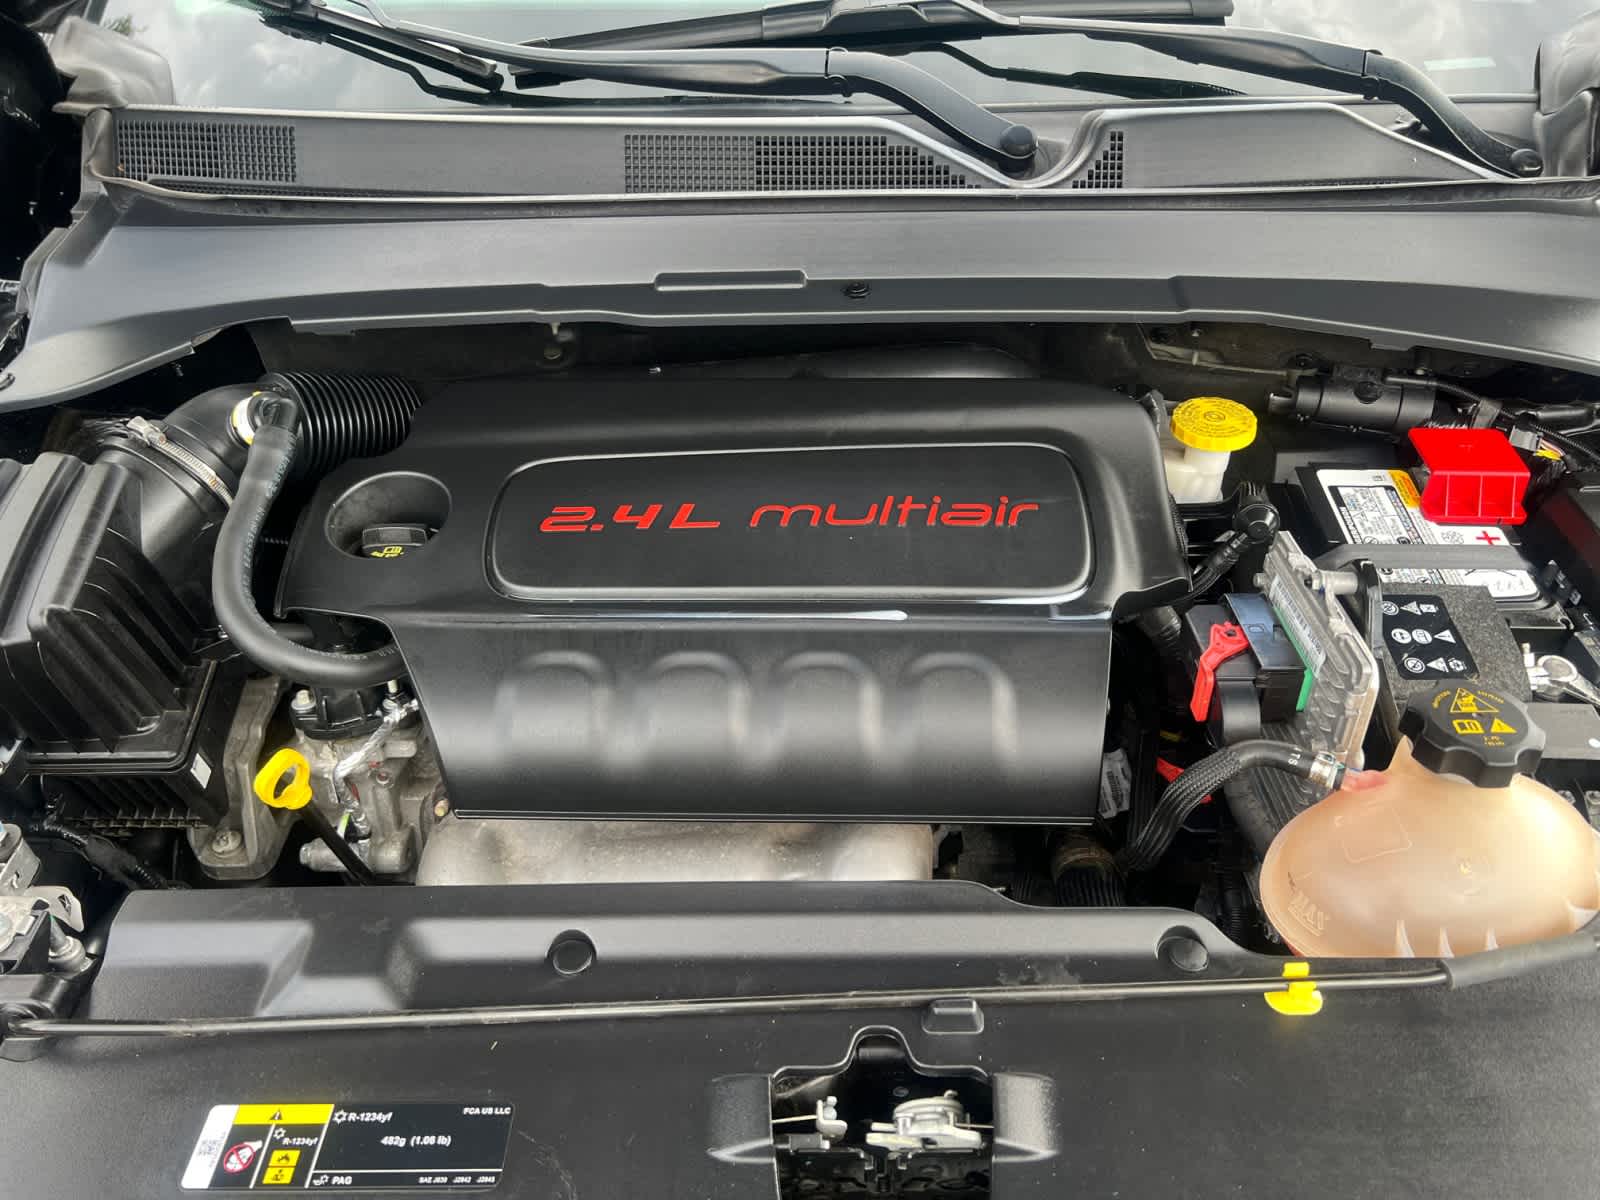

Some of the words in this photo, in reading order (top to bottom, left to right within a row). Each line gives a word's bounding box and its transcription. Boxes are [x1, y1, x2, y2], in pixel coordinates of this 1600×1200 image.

[540, 503, 721, 532] 2.4L
[750, 495, 1039, 527] multiair
[463, 1106, 481, 1115] FCA
[494, 1106, 512, 1115] LLC
[347, 1110, 394, 1124] R-1234yf
[282, 1136, 319, 1147] R-1234yf
[380, 1135, 407, 1148] 482g
[332, 1176, 353, 1185] PAG
